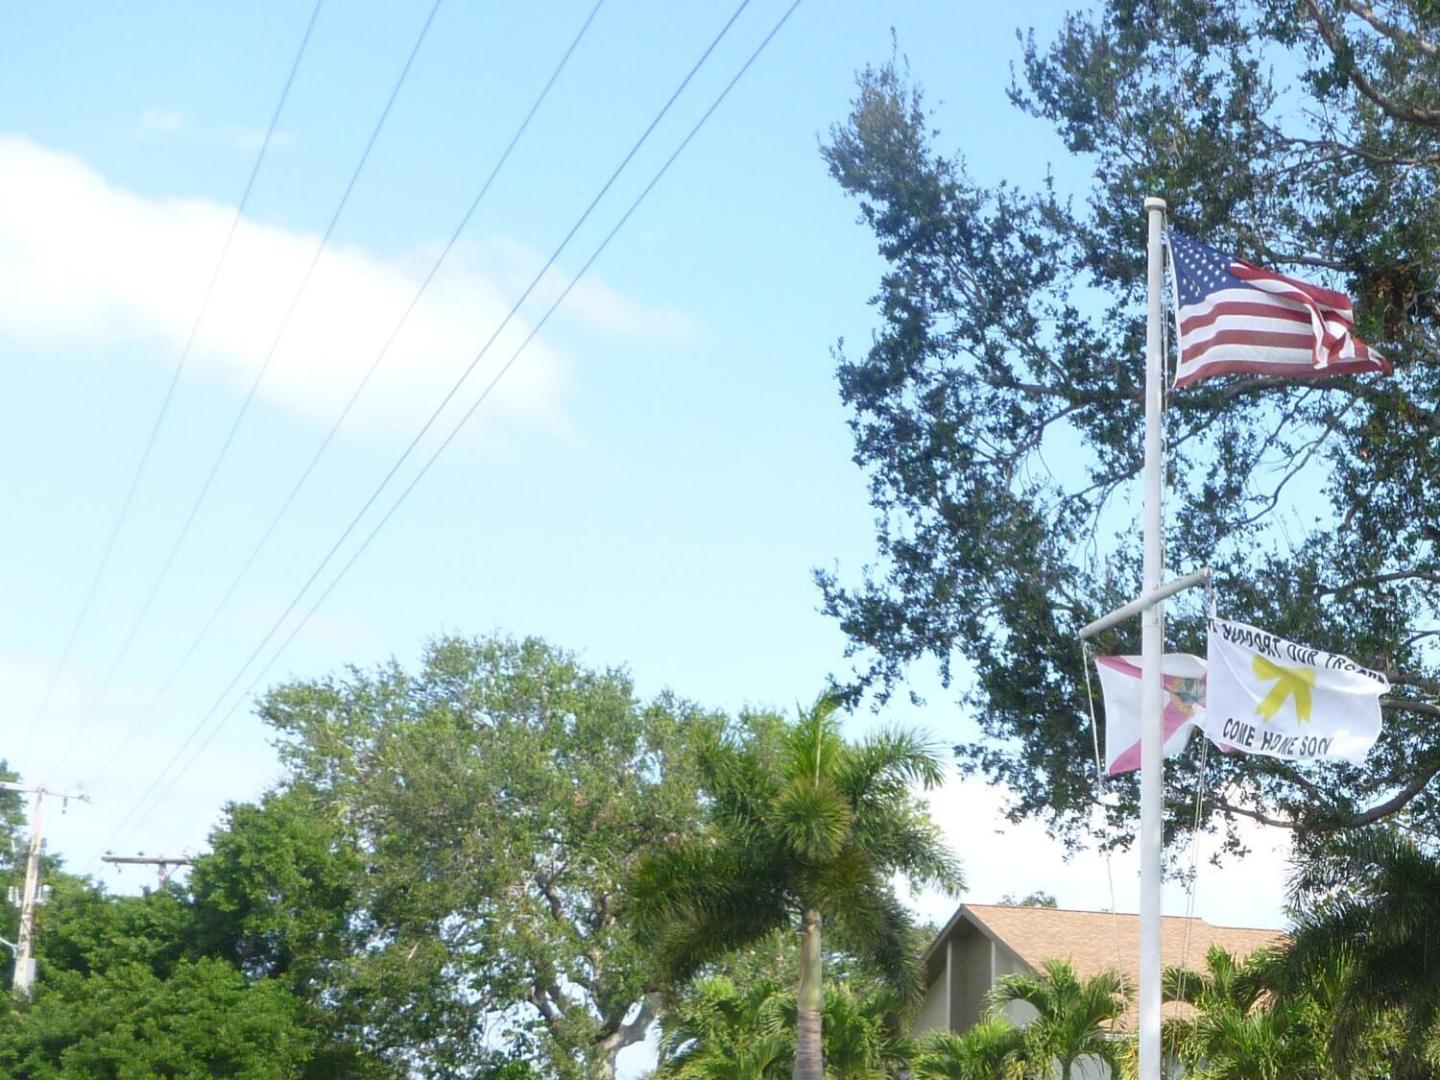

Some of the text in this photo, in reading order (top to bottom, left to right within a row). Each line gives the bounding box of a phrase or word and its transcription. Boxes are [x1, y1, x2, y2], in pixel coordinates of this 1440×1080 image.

[1221, 623, 1281, 658] SUPPORT
[1287, 644, 1319, 667] OUR
[1223, 718, 1256, 747] COME
[1260, 731, 1299, 756] HOME
